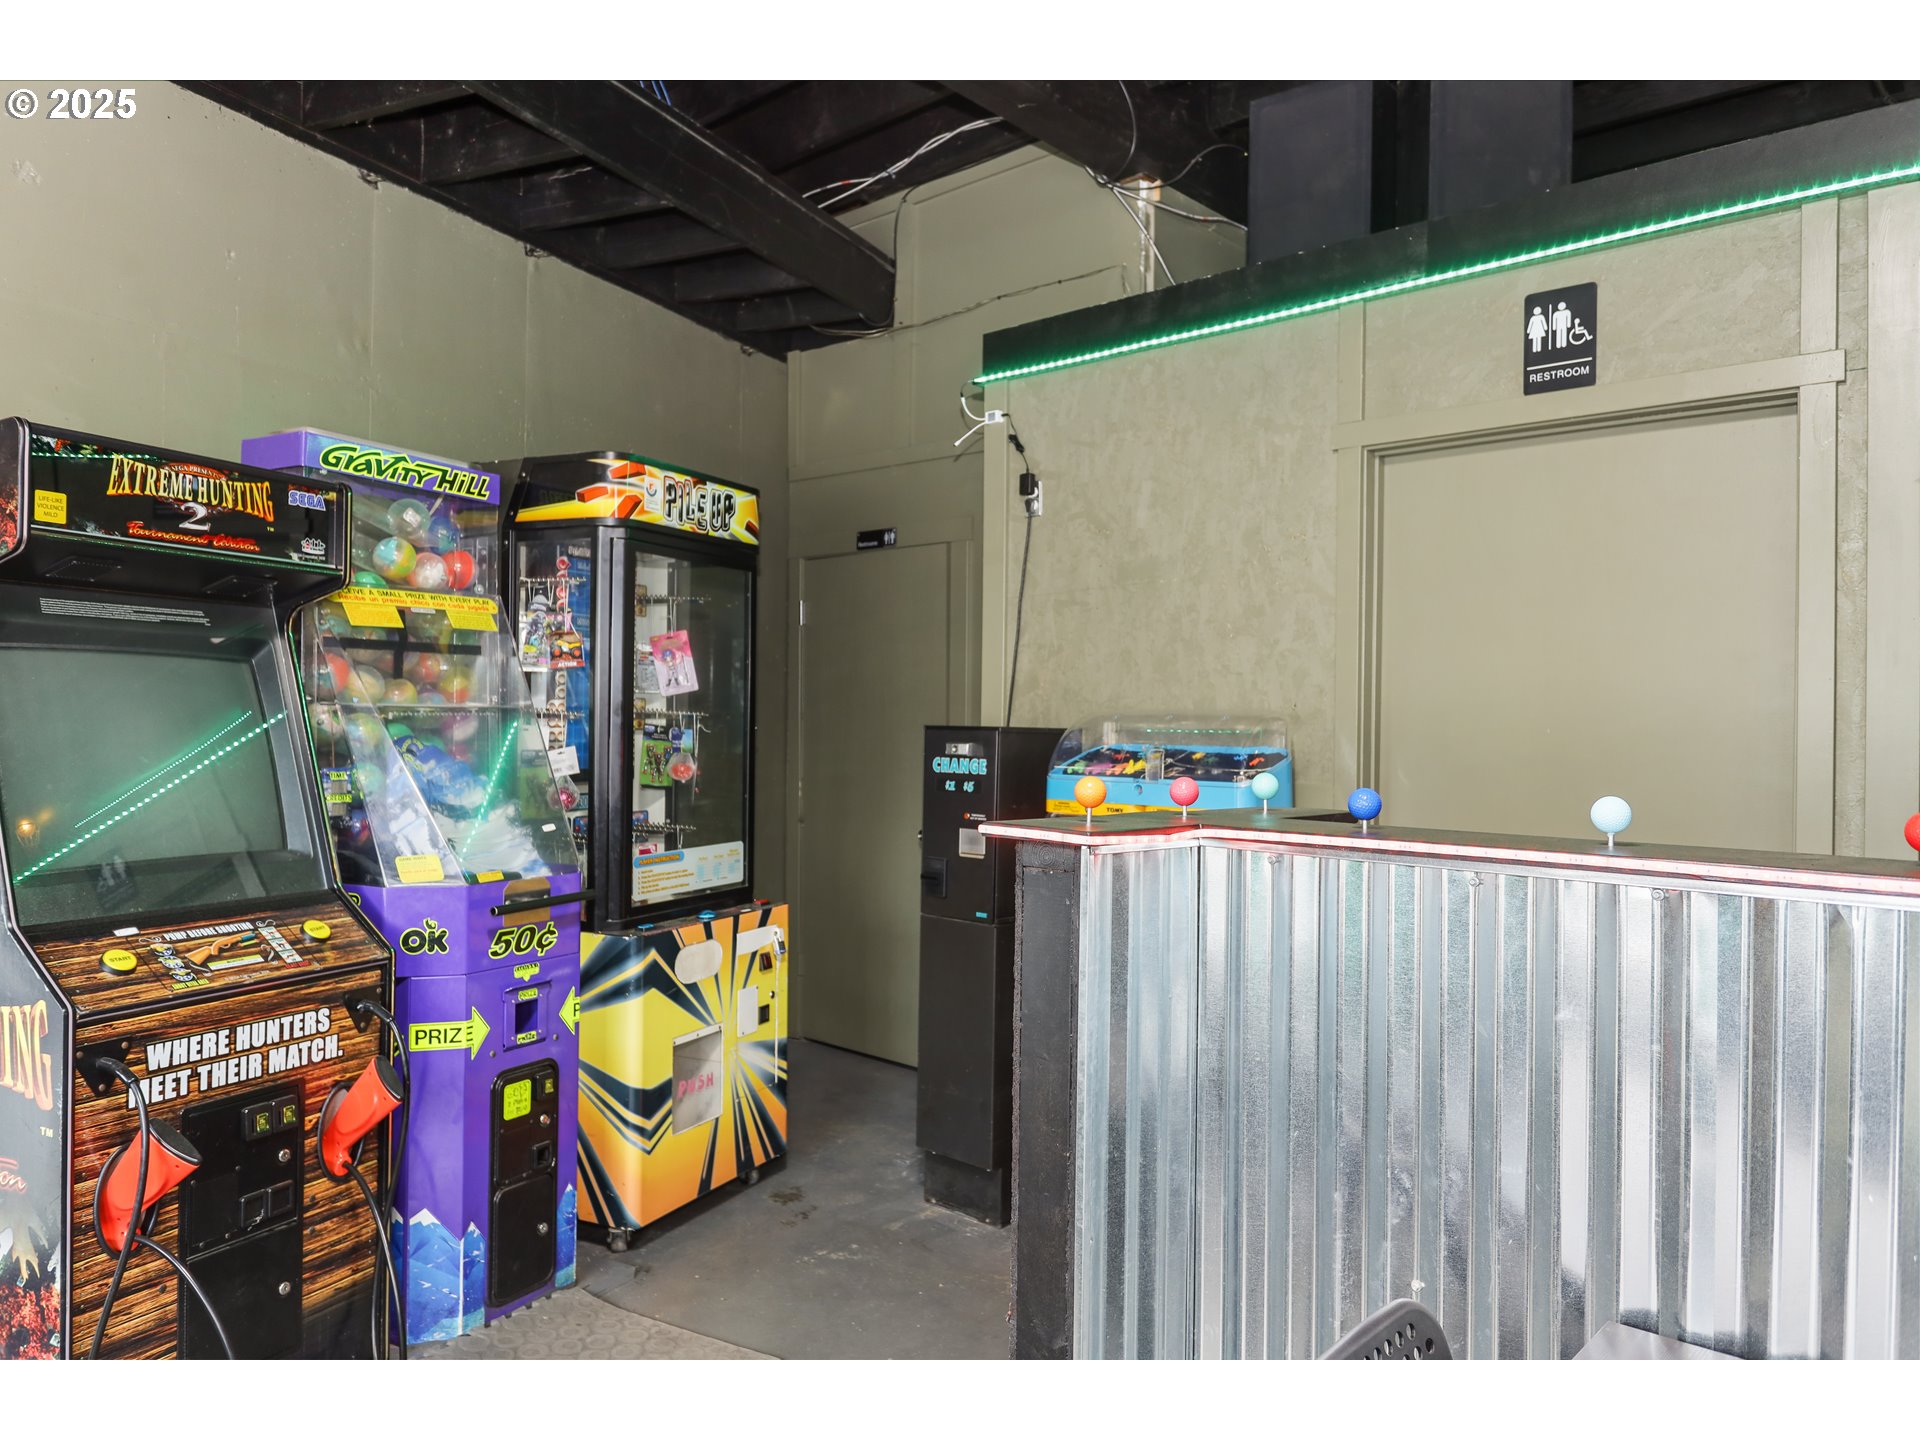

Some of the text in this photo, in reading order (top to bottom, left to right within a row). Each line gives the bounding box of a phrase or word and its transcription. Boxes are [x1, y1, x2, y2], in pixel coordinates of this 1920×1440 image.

[1529, 365, 1590, 383] RESTROOM
[106, 452, 274, 522] EXTREME HUNTING
[288, 489, 326, 511] SEGA
[36, 502, 65, 512] VIOLENCE
[178, 502, 211, 532] 2
[663, 475, 708, 533] PILE
[709, 487, 737, 533] UP
[932, 756, 988, 776] CHANGE
[488, 921, 558, 960] 50¢
[146, 1008, 331, 1072] WHERE HUNTERS
[414, 1025, 474, 1046] PRIZE
[197, 1053, 263, 1092] THEIR
[268, 1034, 344, 1075] MATCH.
[676, 1072, 714, 1102] PUSH
[40, 1126, 53, 1138] TM
